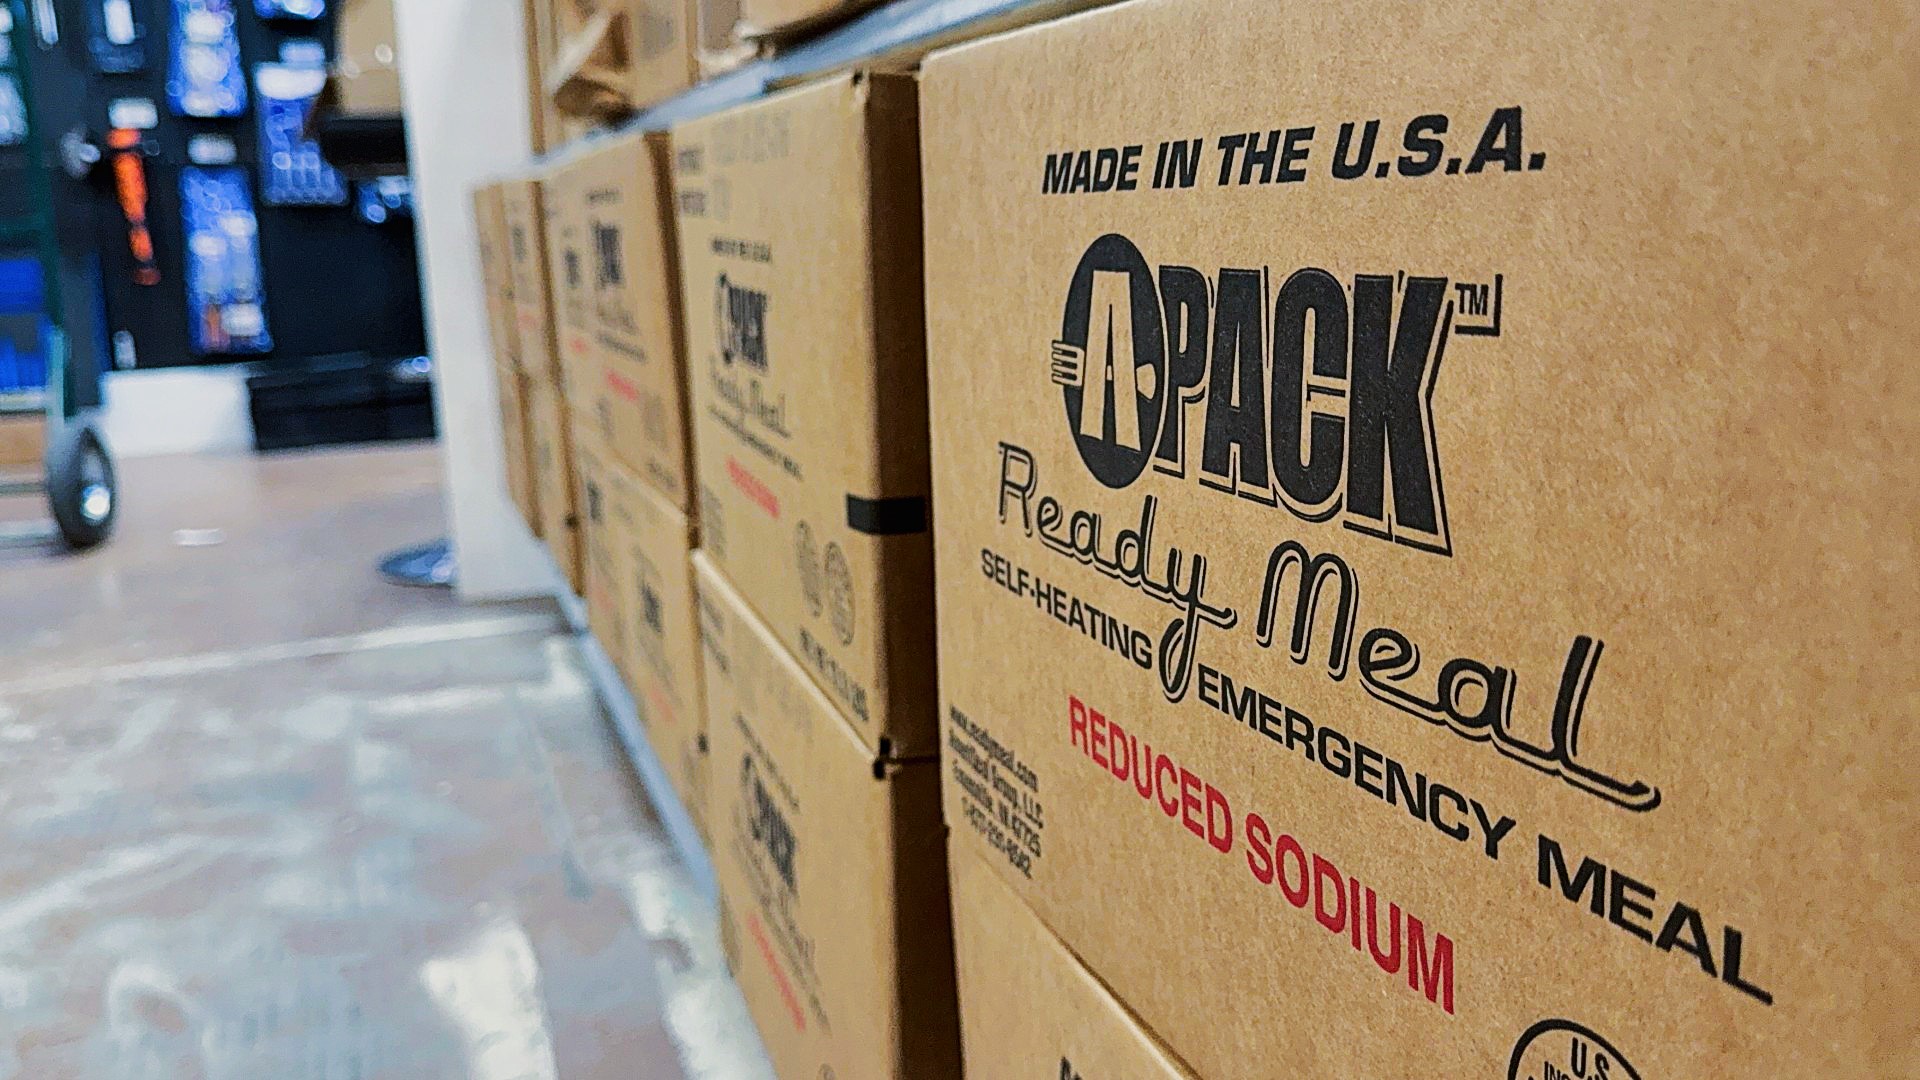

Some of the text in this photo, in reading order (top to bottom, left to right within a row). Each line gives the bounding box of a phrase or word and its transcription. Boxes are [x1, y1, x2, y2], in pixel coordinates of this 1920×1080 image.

[1041, 106, 1547, 194] MADE IN THE U.S.A.
[1454, 282, 1489, 316] TM
[981, 548, 1152, 670] SELF-HEATING
[1198, 662, 1517, 861] EMERGENCY
[1537, 833, 1774, 1006] MEAL
[998, 441, 1238, 704] Ready
[1256, 541, 1662, 812] Meal
[1068, 695, 1233, 855] REDUCED
[1245, 811, 1455, 1016] SODIUM
